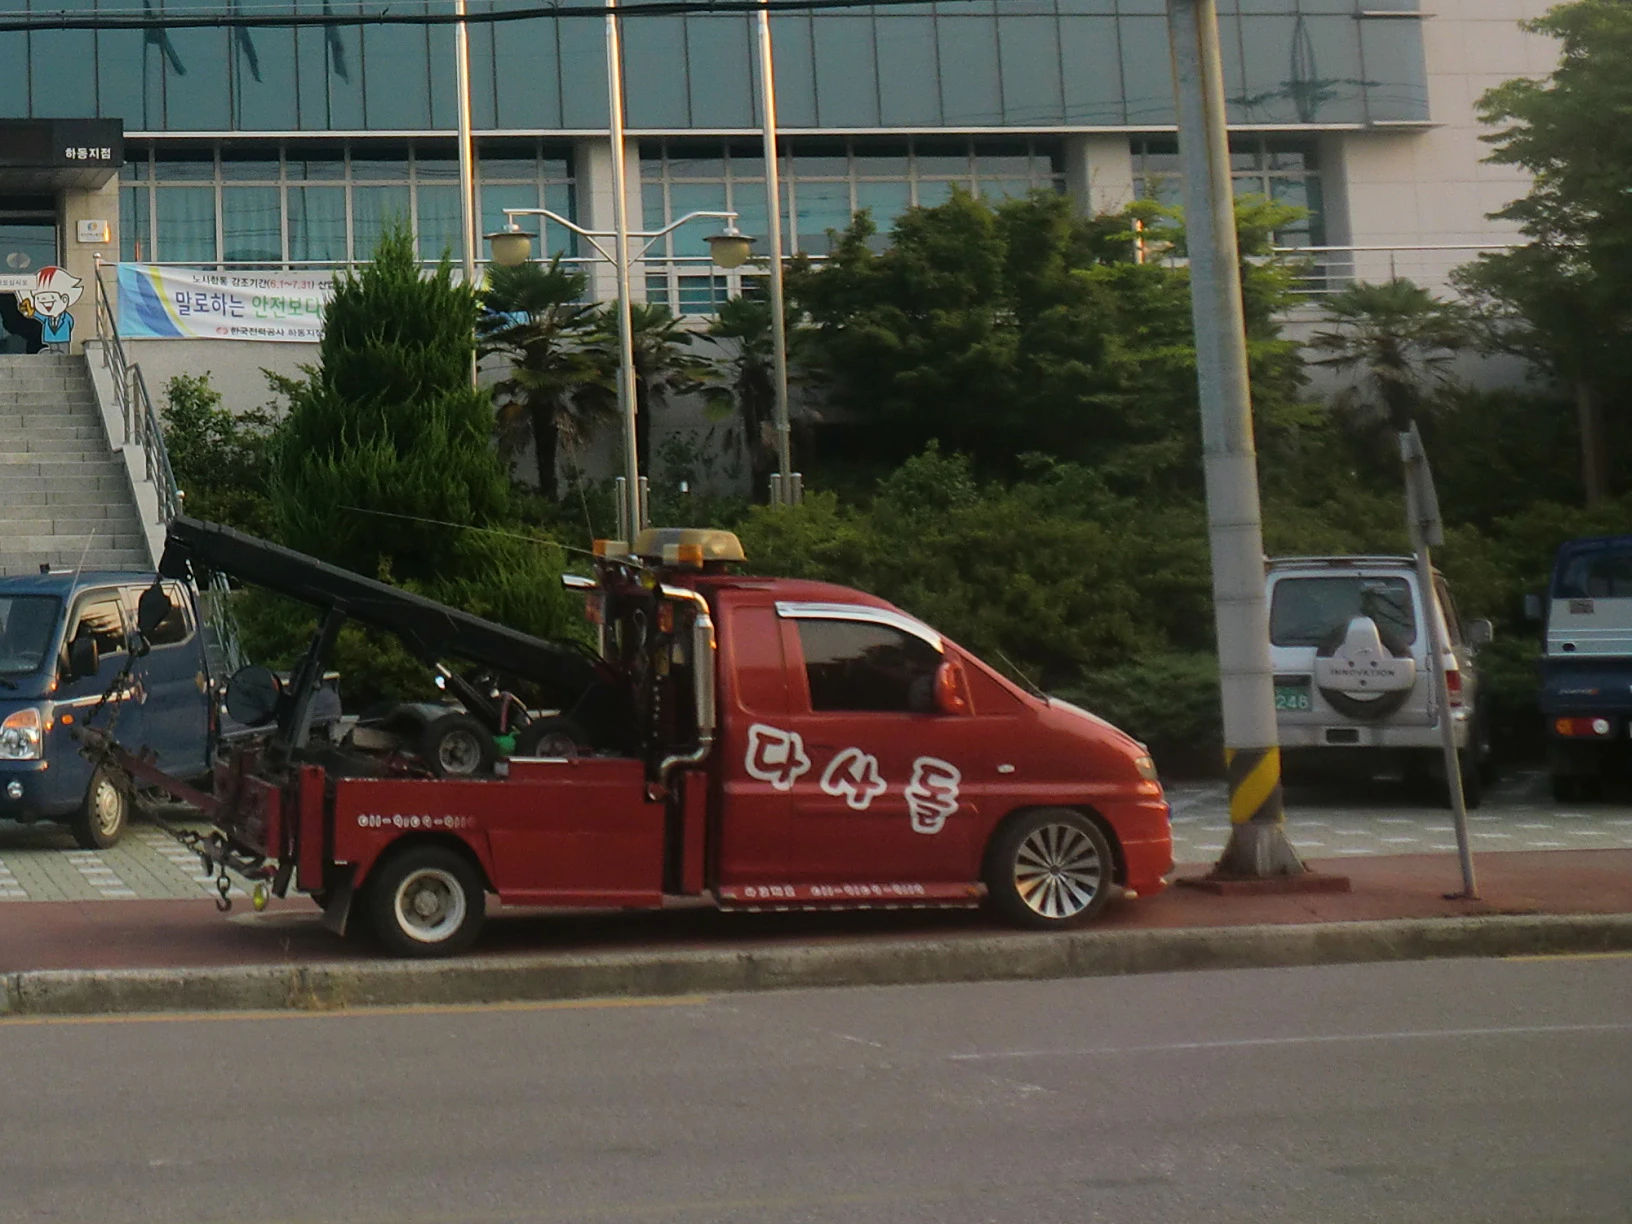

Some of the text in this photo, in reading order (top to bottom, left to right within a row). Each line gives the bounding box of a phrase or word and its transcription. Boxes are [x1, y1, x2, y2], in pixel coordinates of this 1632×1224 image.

[65, 147, 111, 160] 하동지점
[175, 290, 321, 319] 말로하는 안전보다
[230, 326, 284, 336] 한국전력공사
[1330, 668, 1395, 676] INNOVATION
